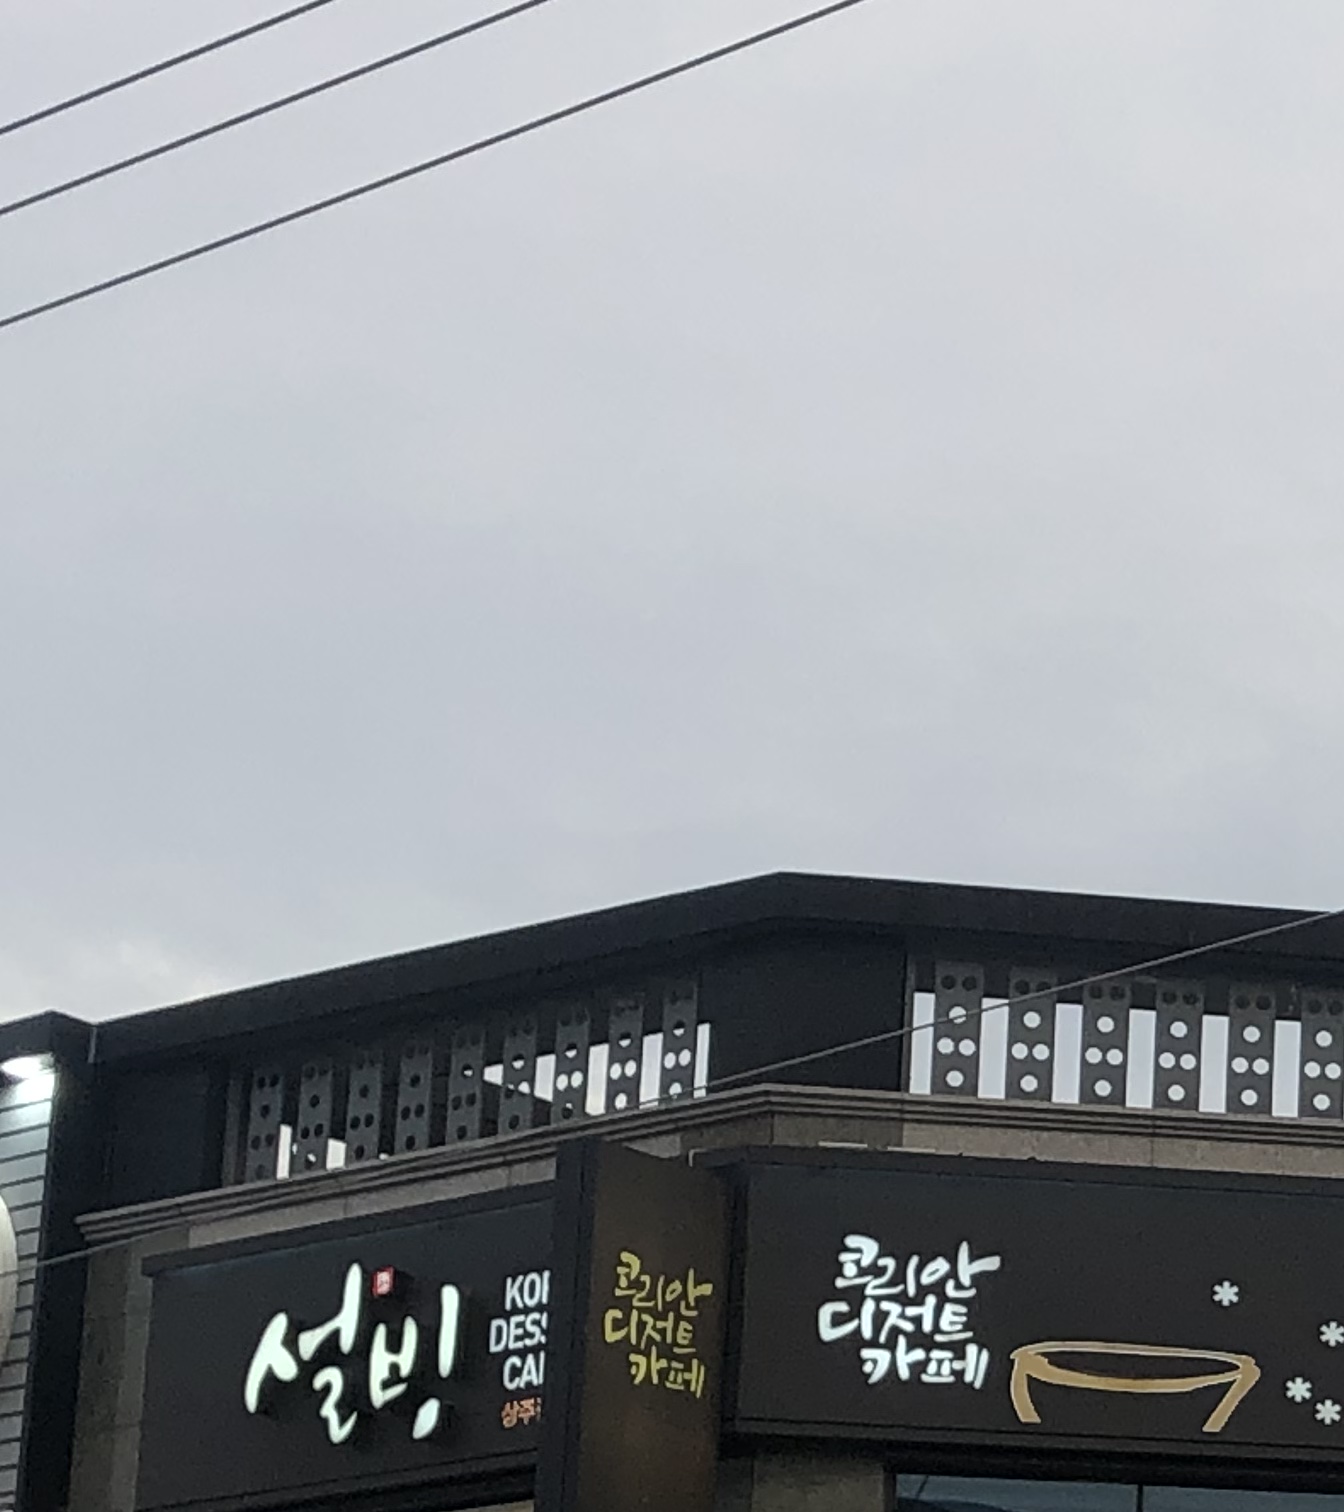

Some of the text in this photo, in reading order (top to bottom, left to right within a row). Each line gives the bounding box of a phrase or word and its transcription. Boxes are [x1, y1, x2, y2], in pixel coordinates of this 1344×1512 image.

[505, 1269, 550, 1312] KO
[615, 1250, 713, 1317] 코리안
[834, 1233, 1001, 1299] 코리안
[604, 1308, 696, 1352] 디저트
[818, 1295, 973, 1342] 디저트
[244, 1262, 459, 1443] 설빙
[503, 1350, 546, 1390] CA
[629, 1345, 705, 1398] 카페
[860, 1336, 989, 1389] 카페
[501, 1397, 542, 1428] 상주
